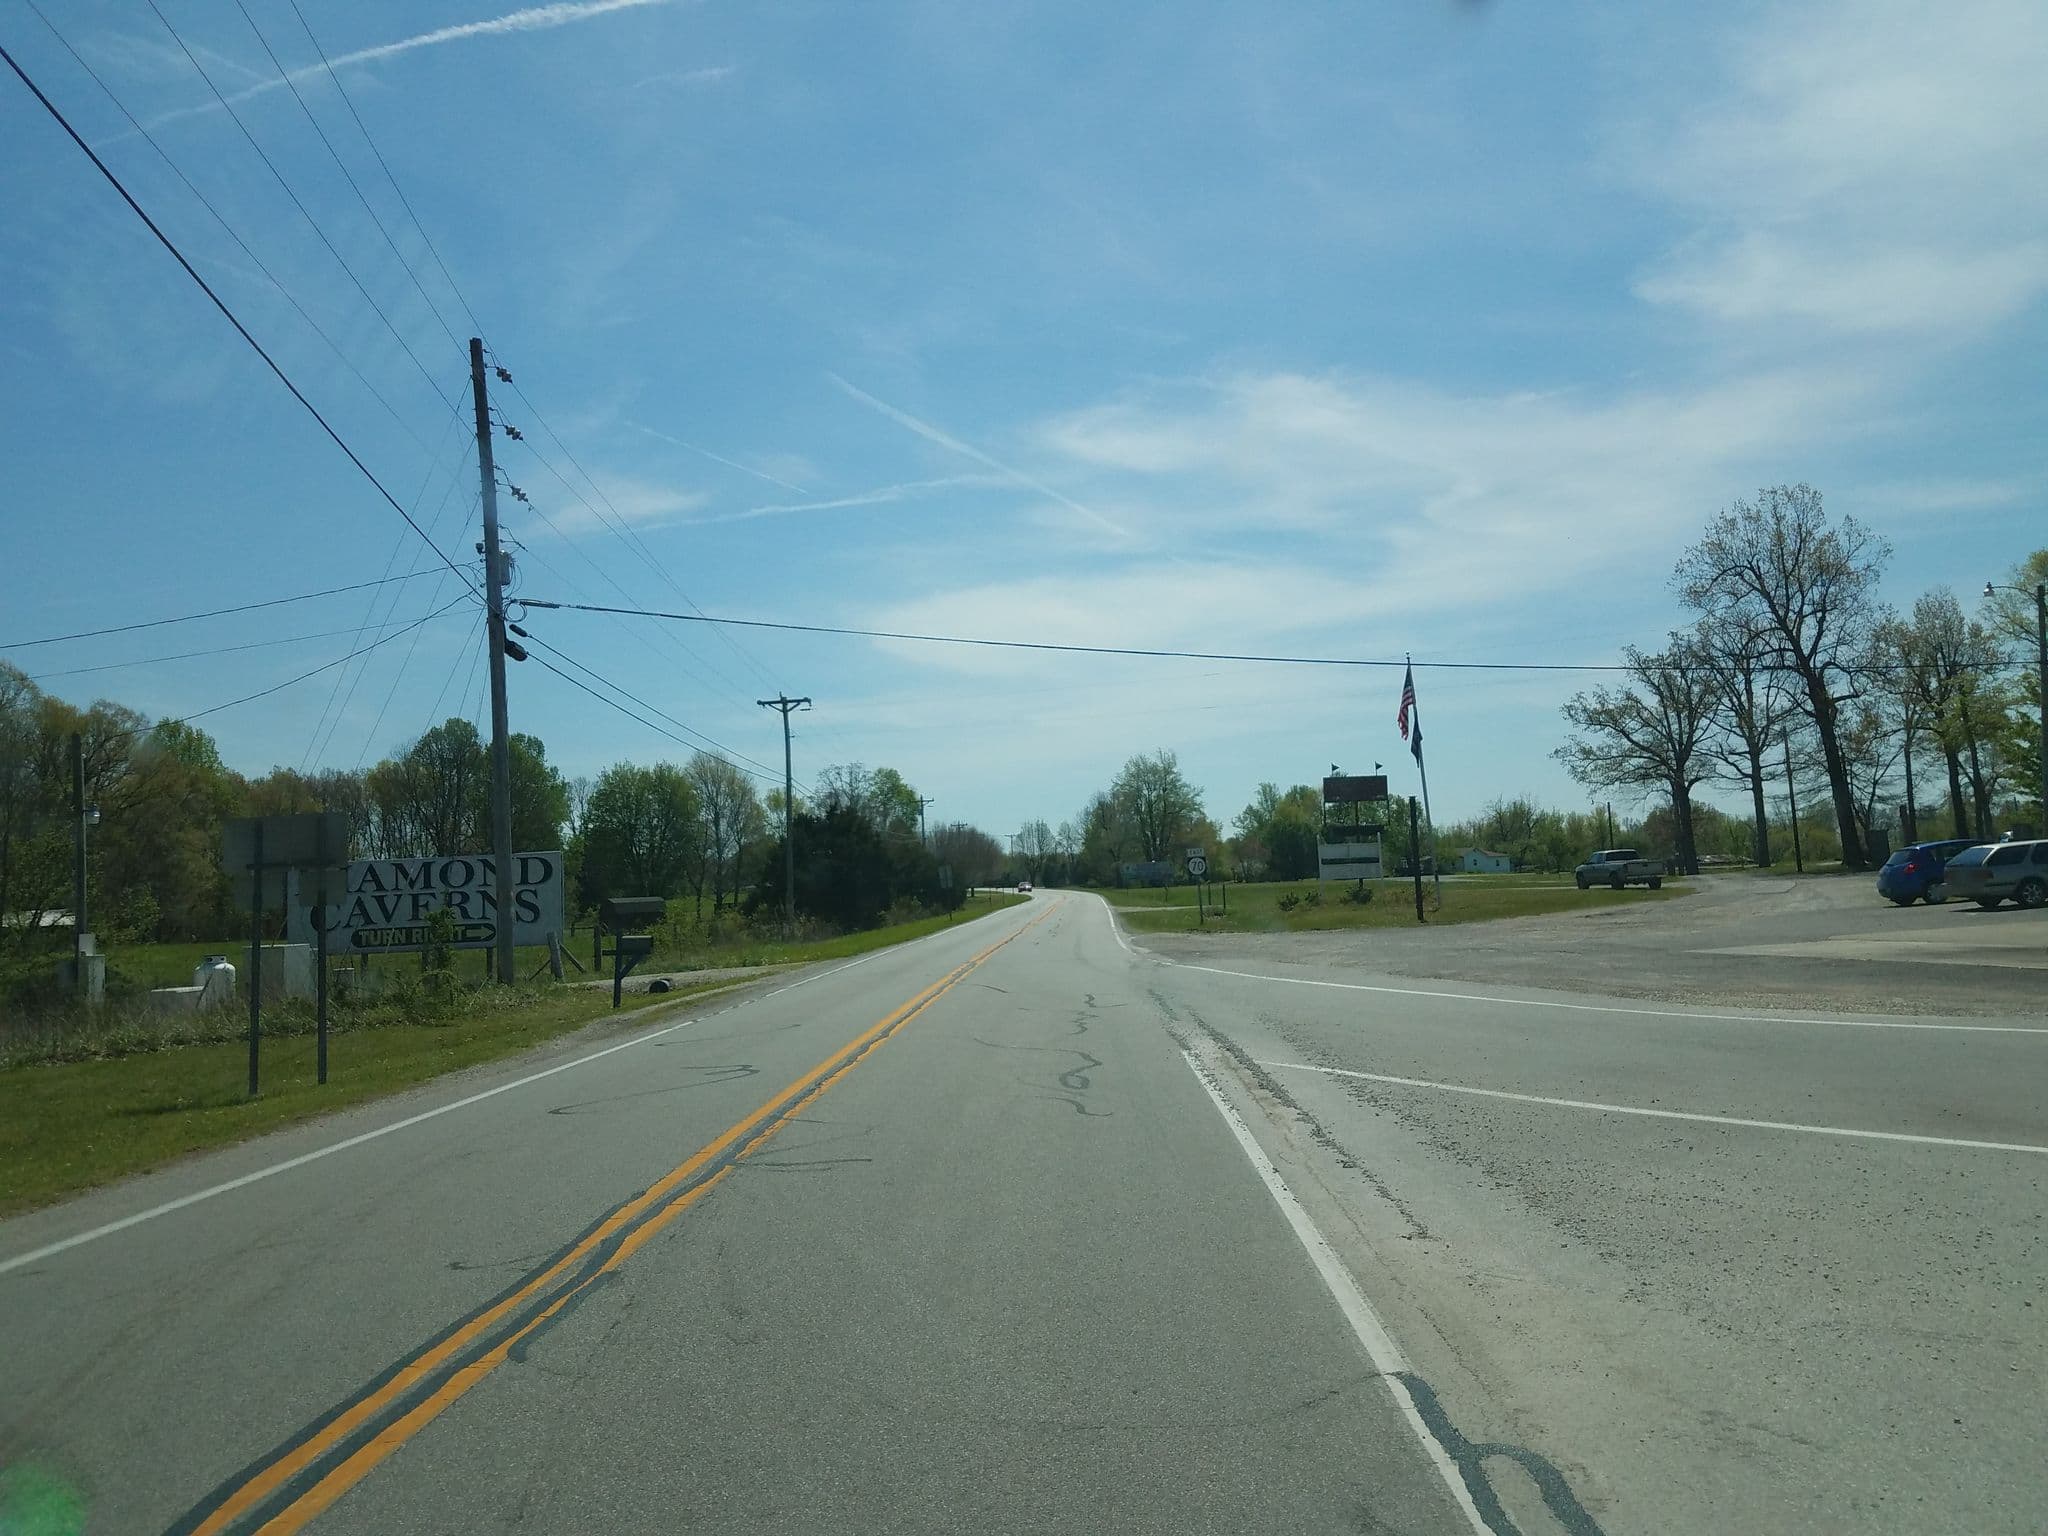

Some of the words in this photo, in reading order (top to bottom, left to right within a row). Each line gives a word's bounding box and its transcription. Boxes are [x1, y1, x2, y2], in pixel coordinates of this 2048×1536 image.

[346, 856, 553, 893] AMOND
[1191, 860, 1204, 872] 70
[358, 927, 406, 947] TURN
[411, 923, 464, 945] RIT
